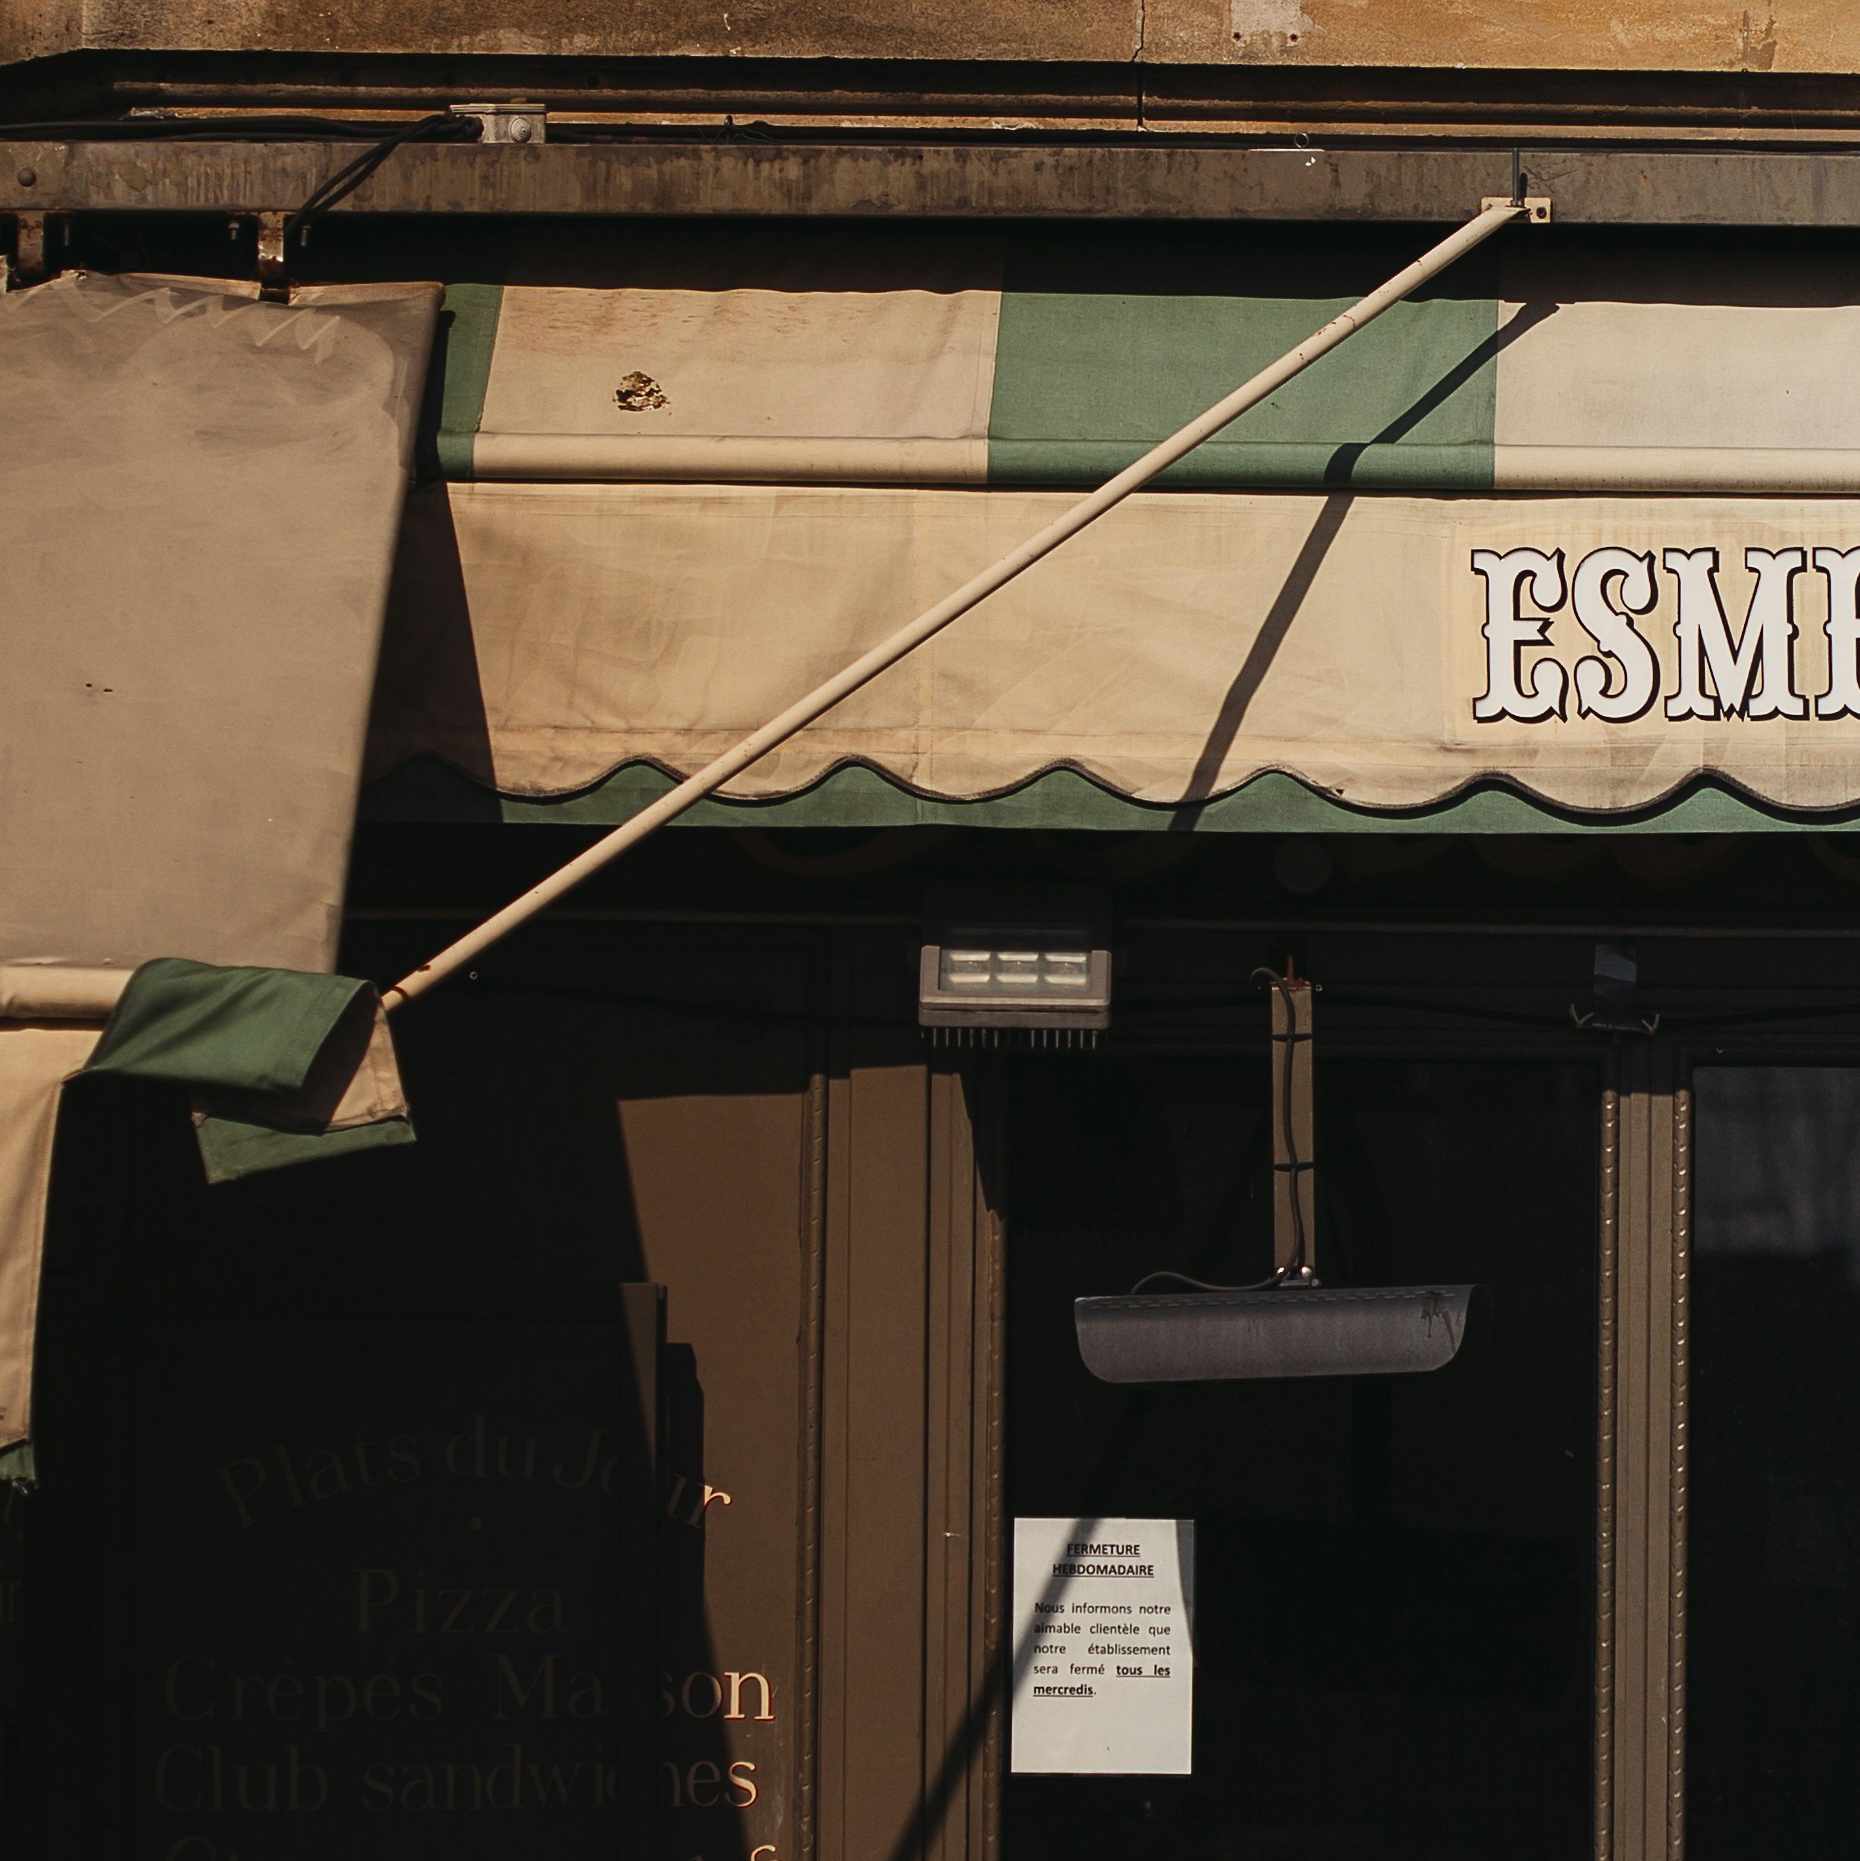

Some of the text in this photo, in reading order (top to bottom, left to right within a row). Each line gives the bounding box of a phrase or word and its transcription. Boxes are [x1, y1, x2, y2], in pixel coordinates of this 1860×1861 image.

[1067, 1543, 1141, 1557] FERMETURE
[1052, 1564, 1155, 1577] HEBDOMADAIRE
[352, 1567, 570, 1635] Pizza
[1034, 1602, 1171, 1615] Nous informons notre
[1034, 1622, 1171, 1638] aimable clientèle que
[1034, 1643, 1171, 1656] notre établissement
[1033, 1663, 1171, 1677] sera fermé tous les
[1033, 1684, 1097, 1697] mercredis.
[154, 1743, 329, 1813] Club
